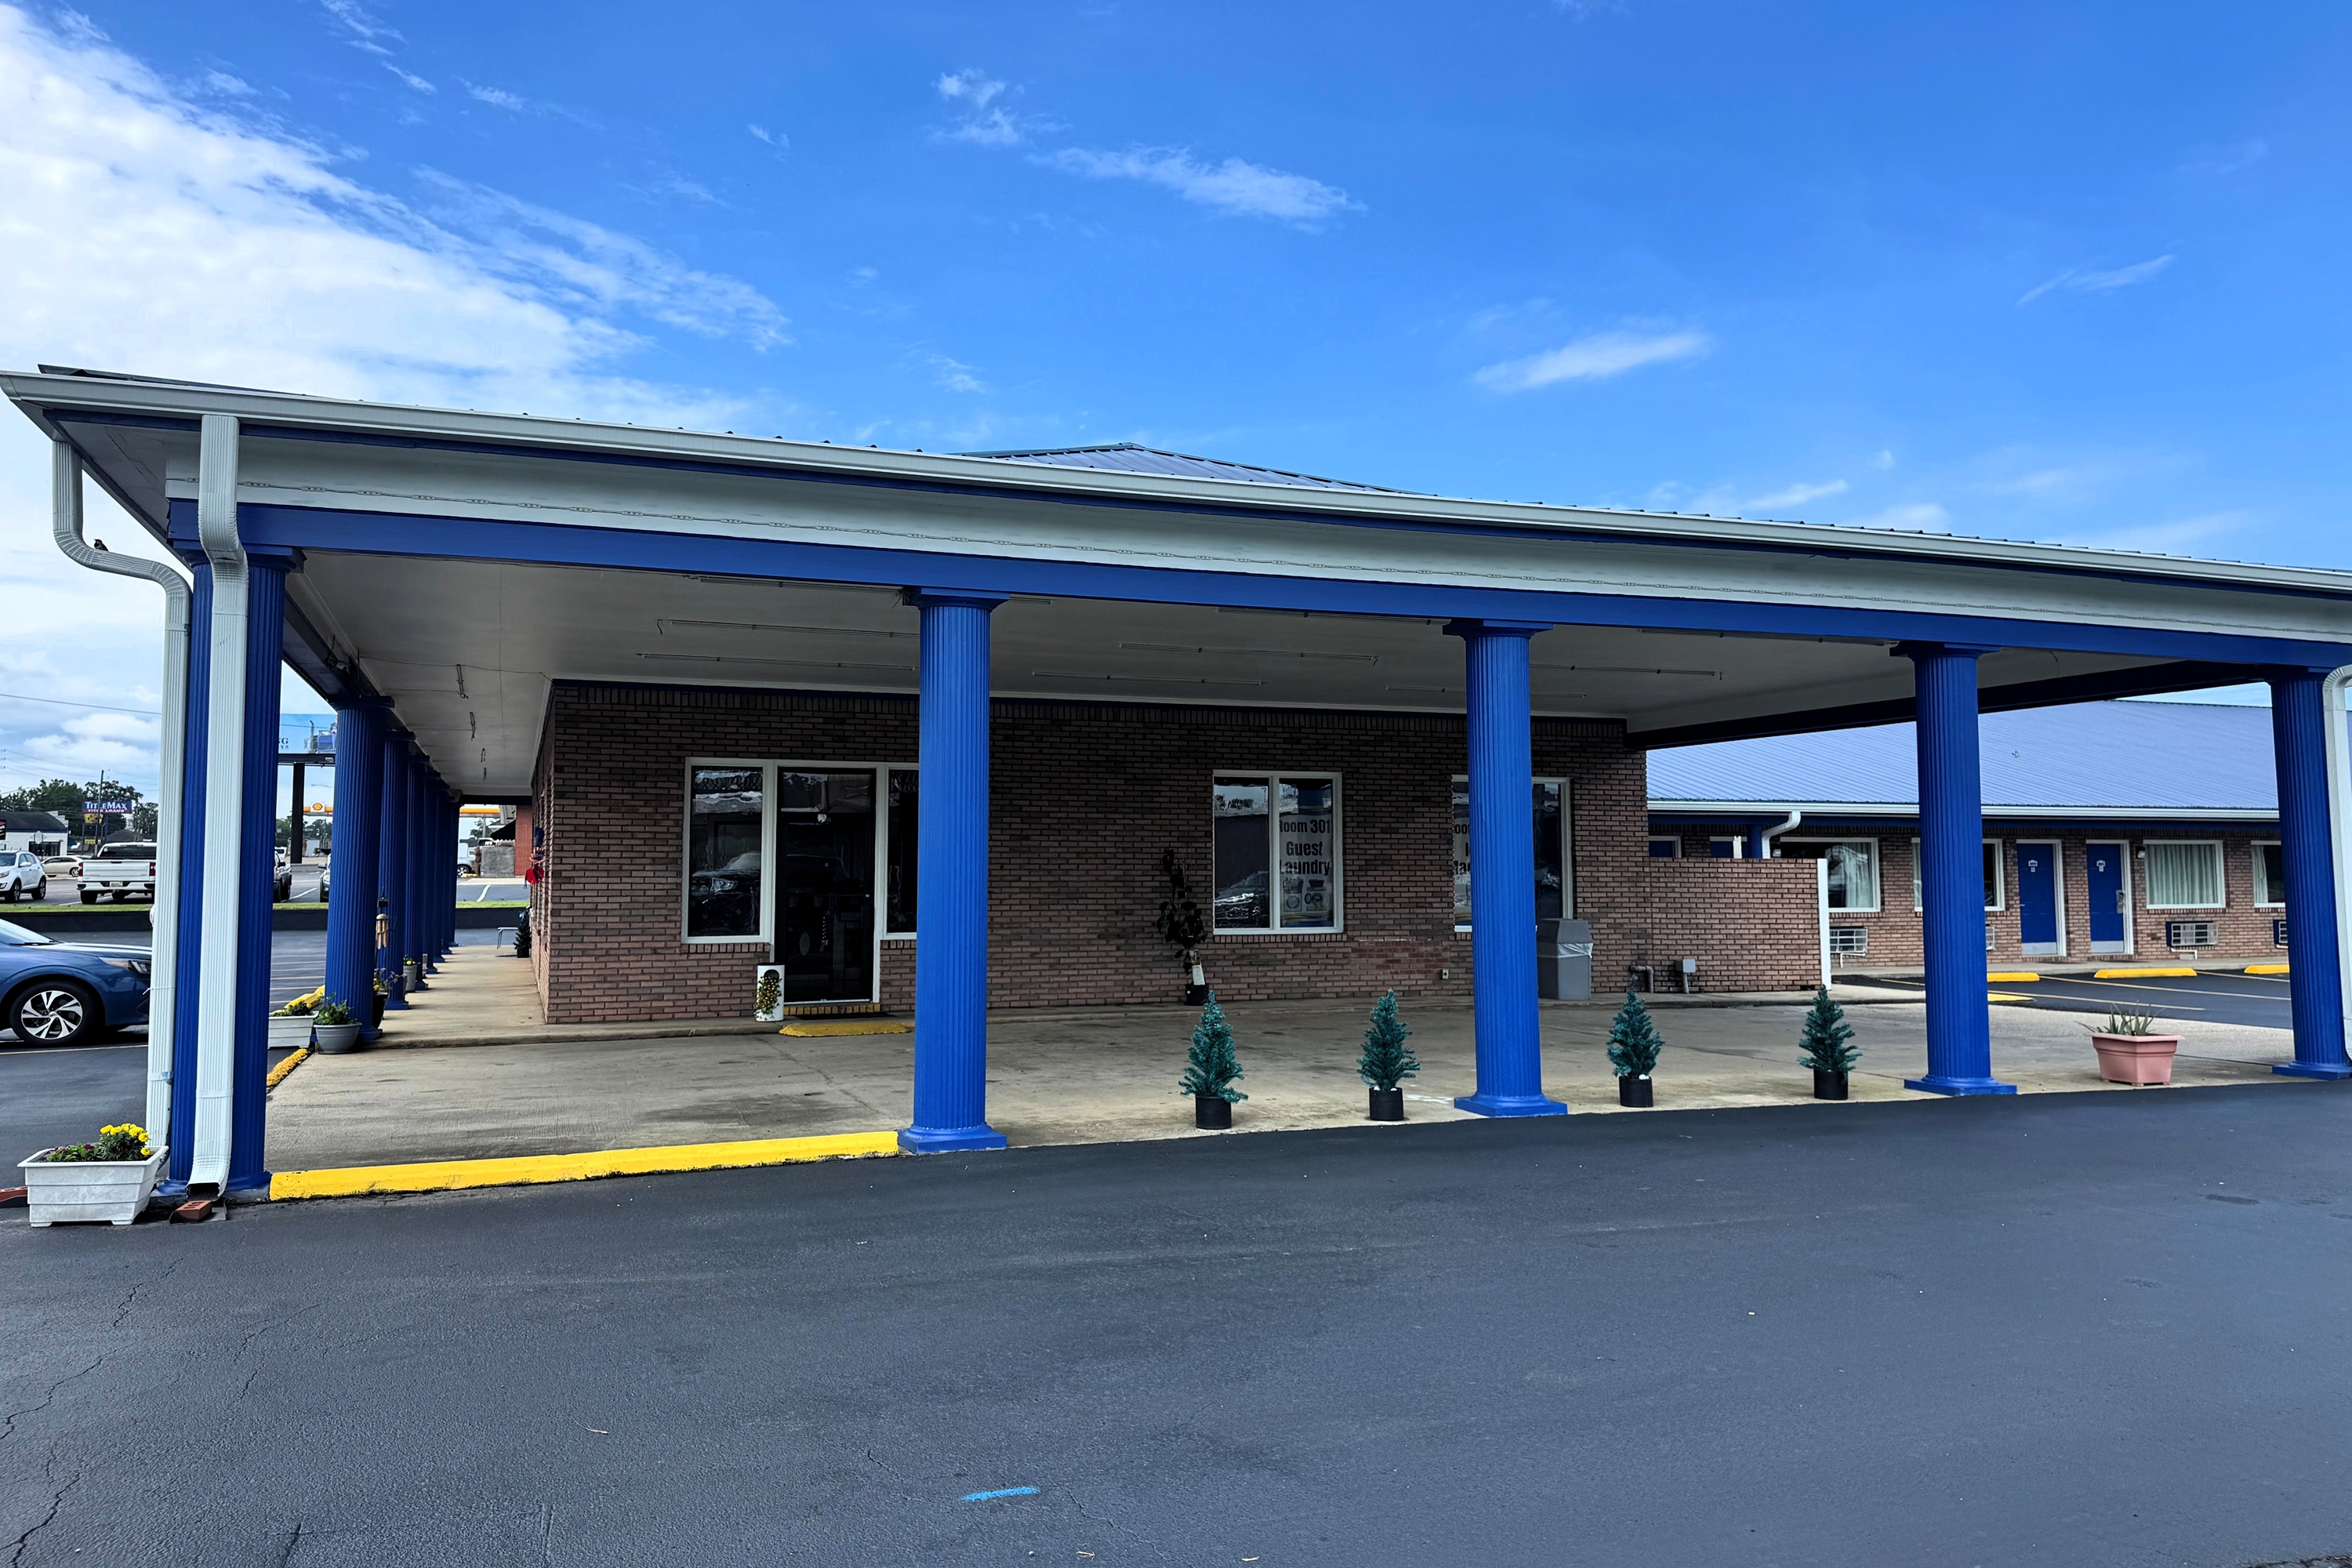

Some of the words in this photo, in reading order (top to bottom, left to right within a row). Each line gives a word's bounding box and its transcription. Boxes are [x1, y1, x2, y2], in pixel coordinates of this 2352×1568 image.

[1310, 819, 1330, 833] 301
[1287, 841, 1323, 856] Guest
[1279, 859, 1330, 876] Laundry
